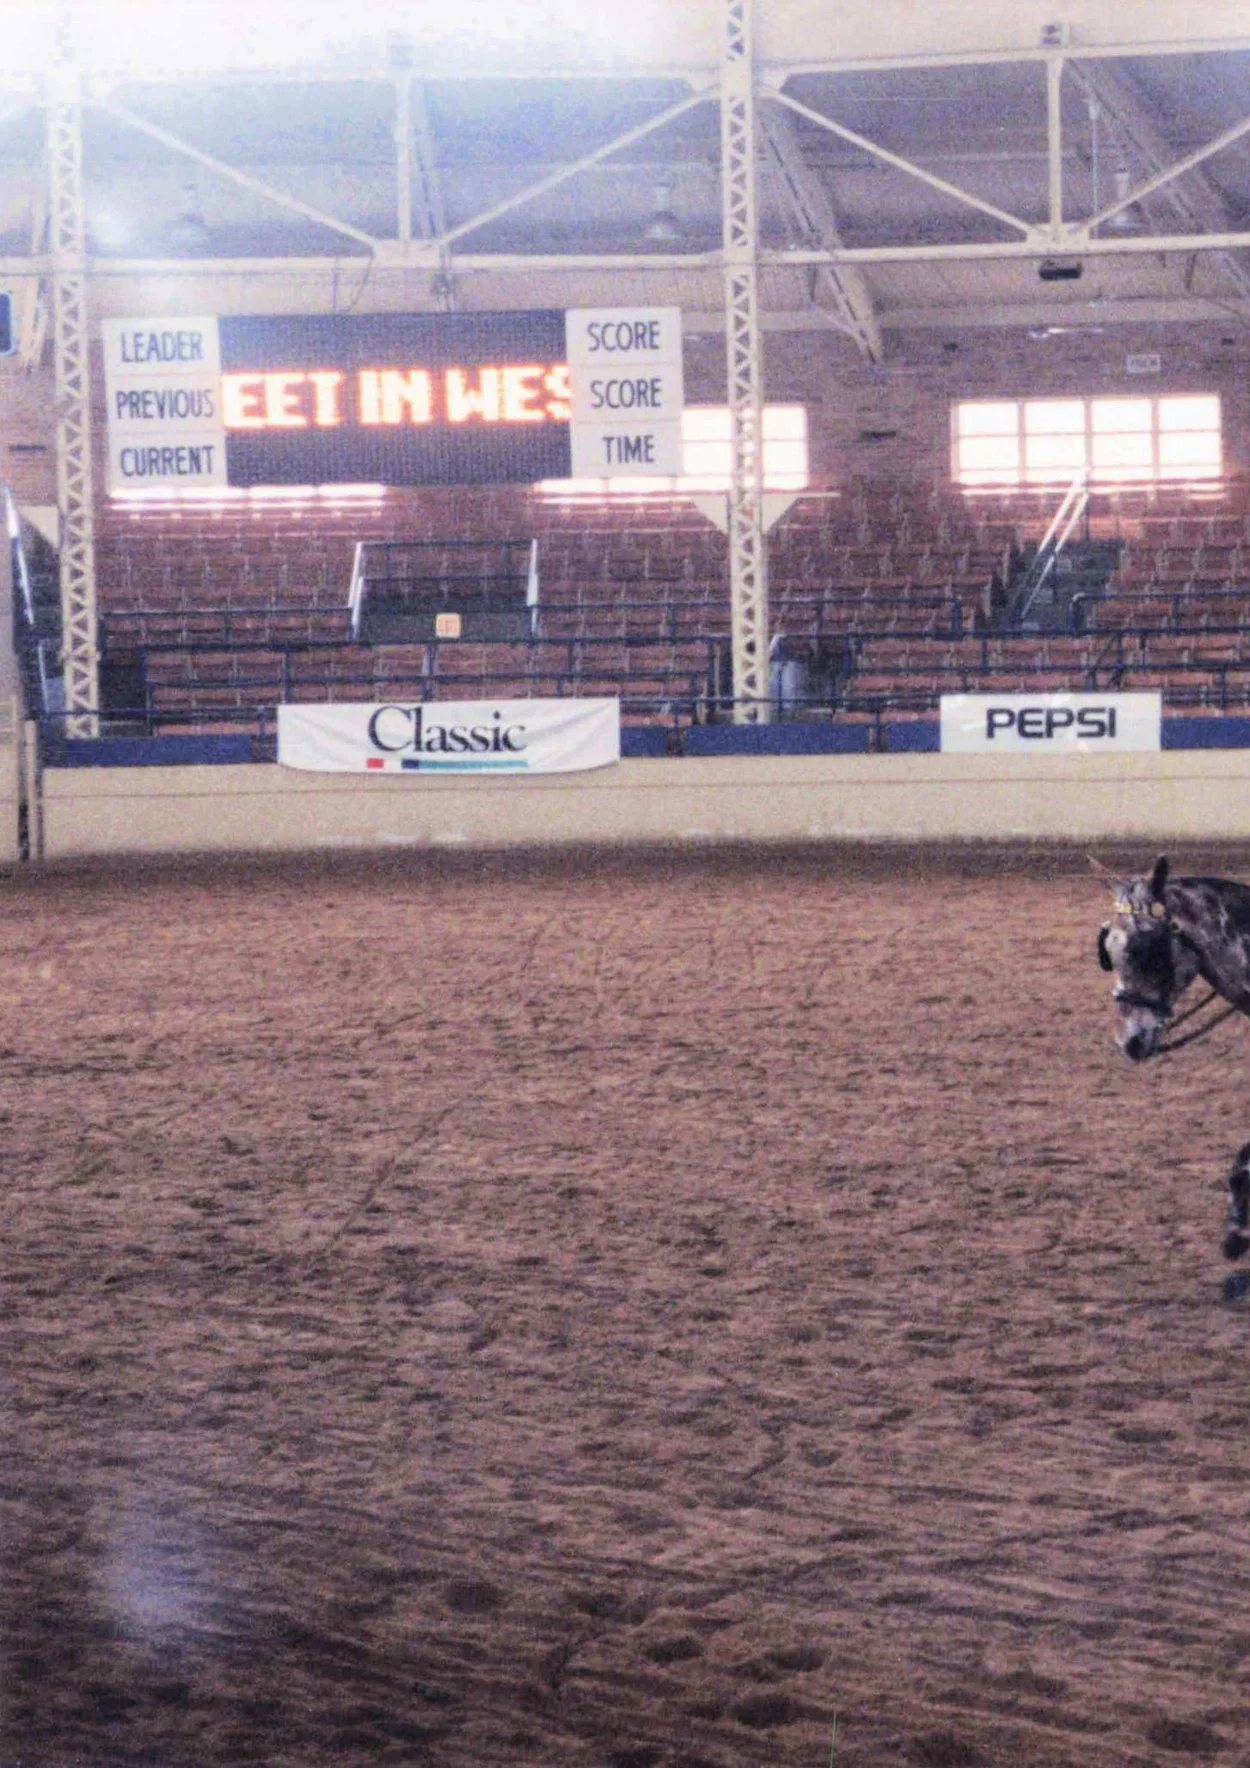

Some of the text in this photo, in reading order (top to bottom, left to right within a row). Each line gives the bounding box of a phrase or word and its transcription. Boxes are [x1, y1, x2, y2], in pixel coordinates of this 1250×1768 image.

[121, 331, 203, 363] LEADER
[587, 321, 660, 351] SCORE
[116, 388, 216, 420] PREVIOUS
[221, 368, 344, 429] EET
[357, 366, 432, 426] IN
[590, 378, 662, 409] SCORE
[120, 445, 214, 477] CURRENT
[602, 434, 655, 464] TIME
[367, 705, 529, 753] Classic
[986, 707, 1117, 739] PEPSI
